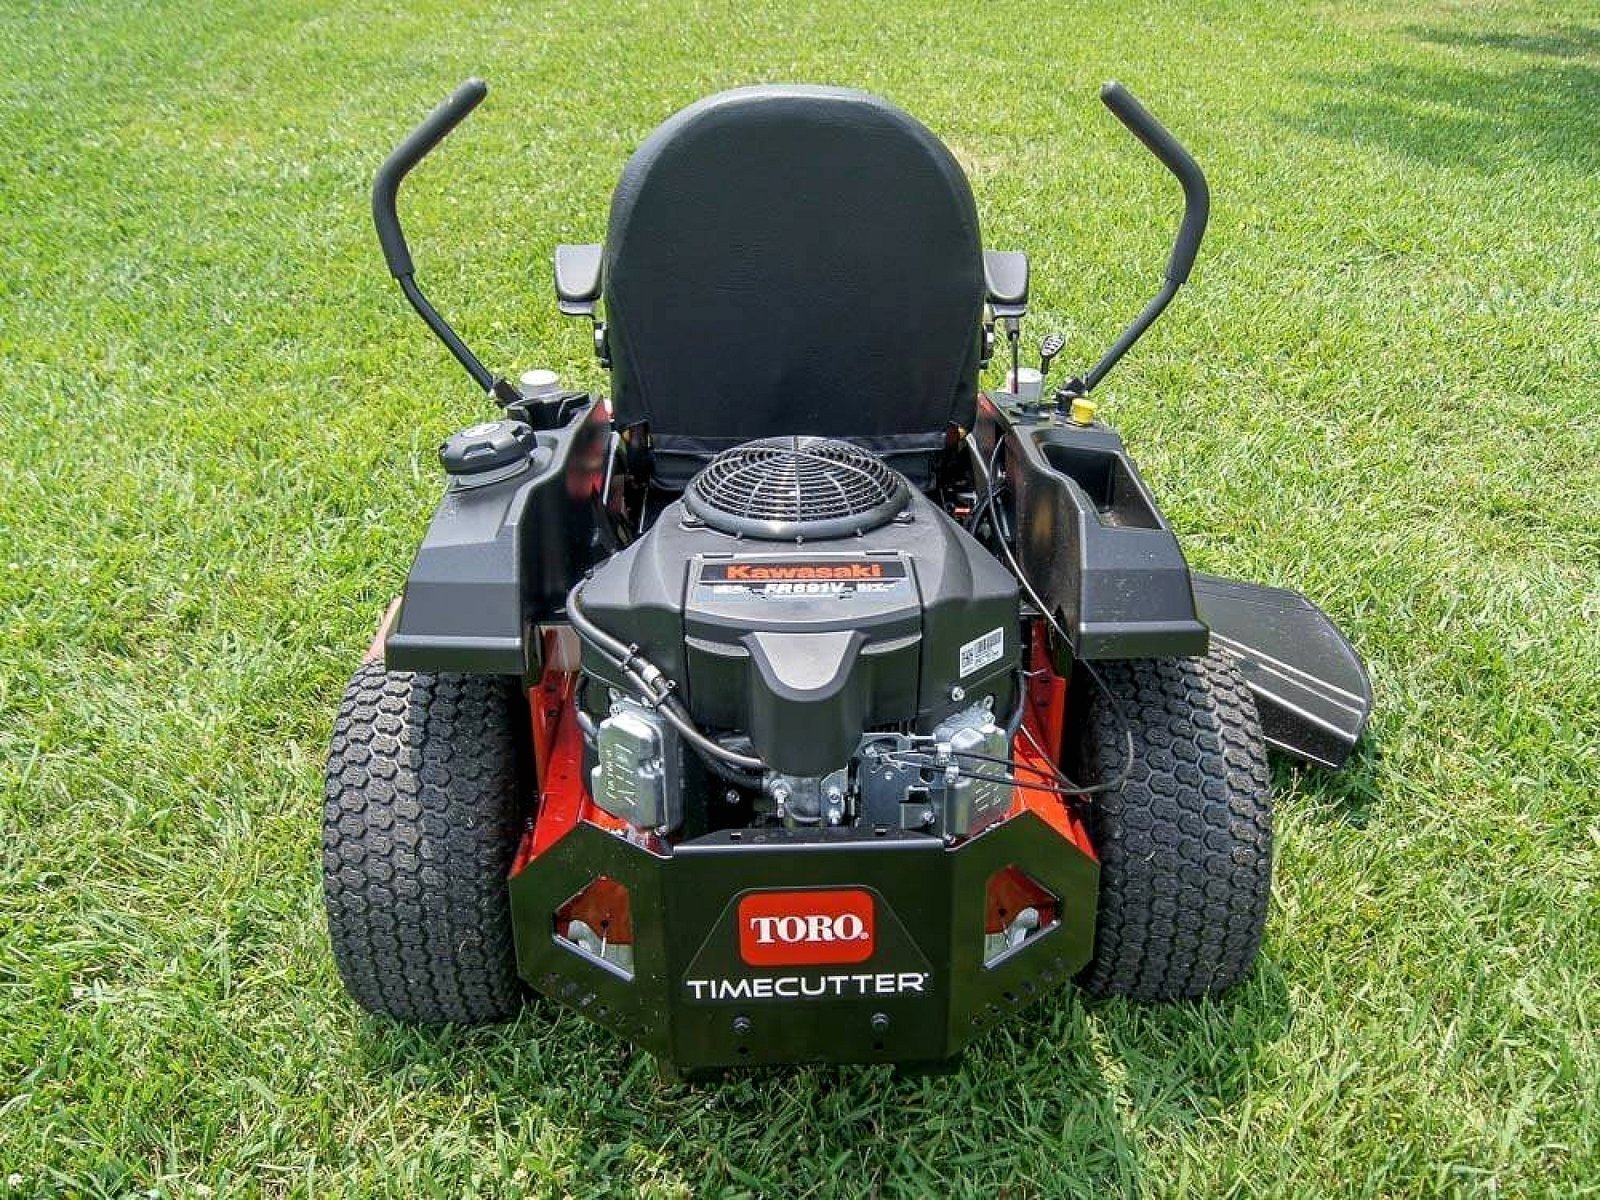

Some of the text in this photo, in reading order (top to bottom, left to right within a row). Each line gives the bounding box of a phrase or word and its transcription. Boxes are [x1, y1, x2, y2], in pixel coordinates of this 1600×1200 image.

[726, 564, 883, 580] Kawasaki
[750, 914, 863, 943] TORO
[687, 973, 925, 999] TIMECUTTER
